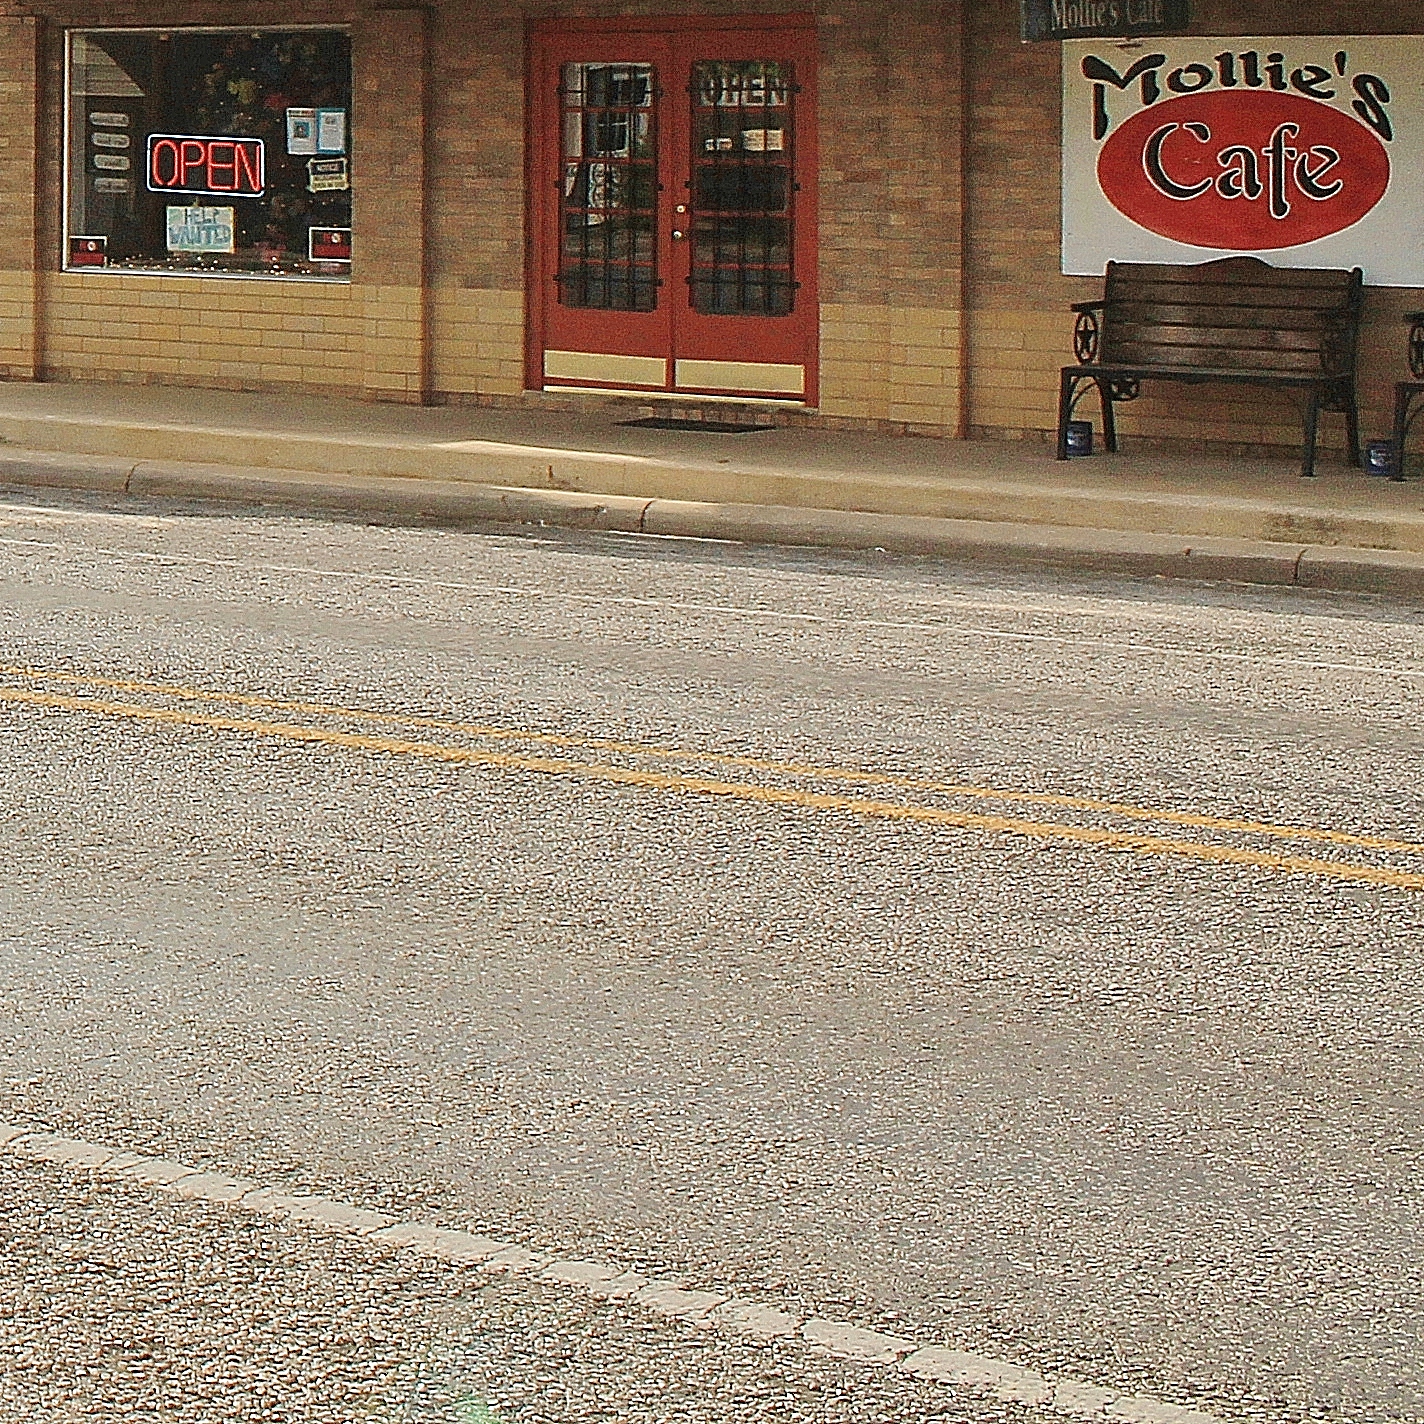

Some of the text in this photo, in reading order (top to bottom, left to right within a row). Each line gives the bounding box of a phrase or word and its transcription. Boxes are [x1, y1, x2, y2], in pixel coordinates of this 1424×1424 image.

[1081, 51, 1393, 141] Mollie's
[152, 139, 261, 193] OPEN
[1142, 122, 1344, 219] Cafe
[184, 207, 218, 224] HELP
